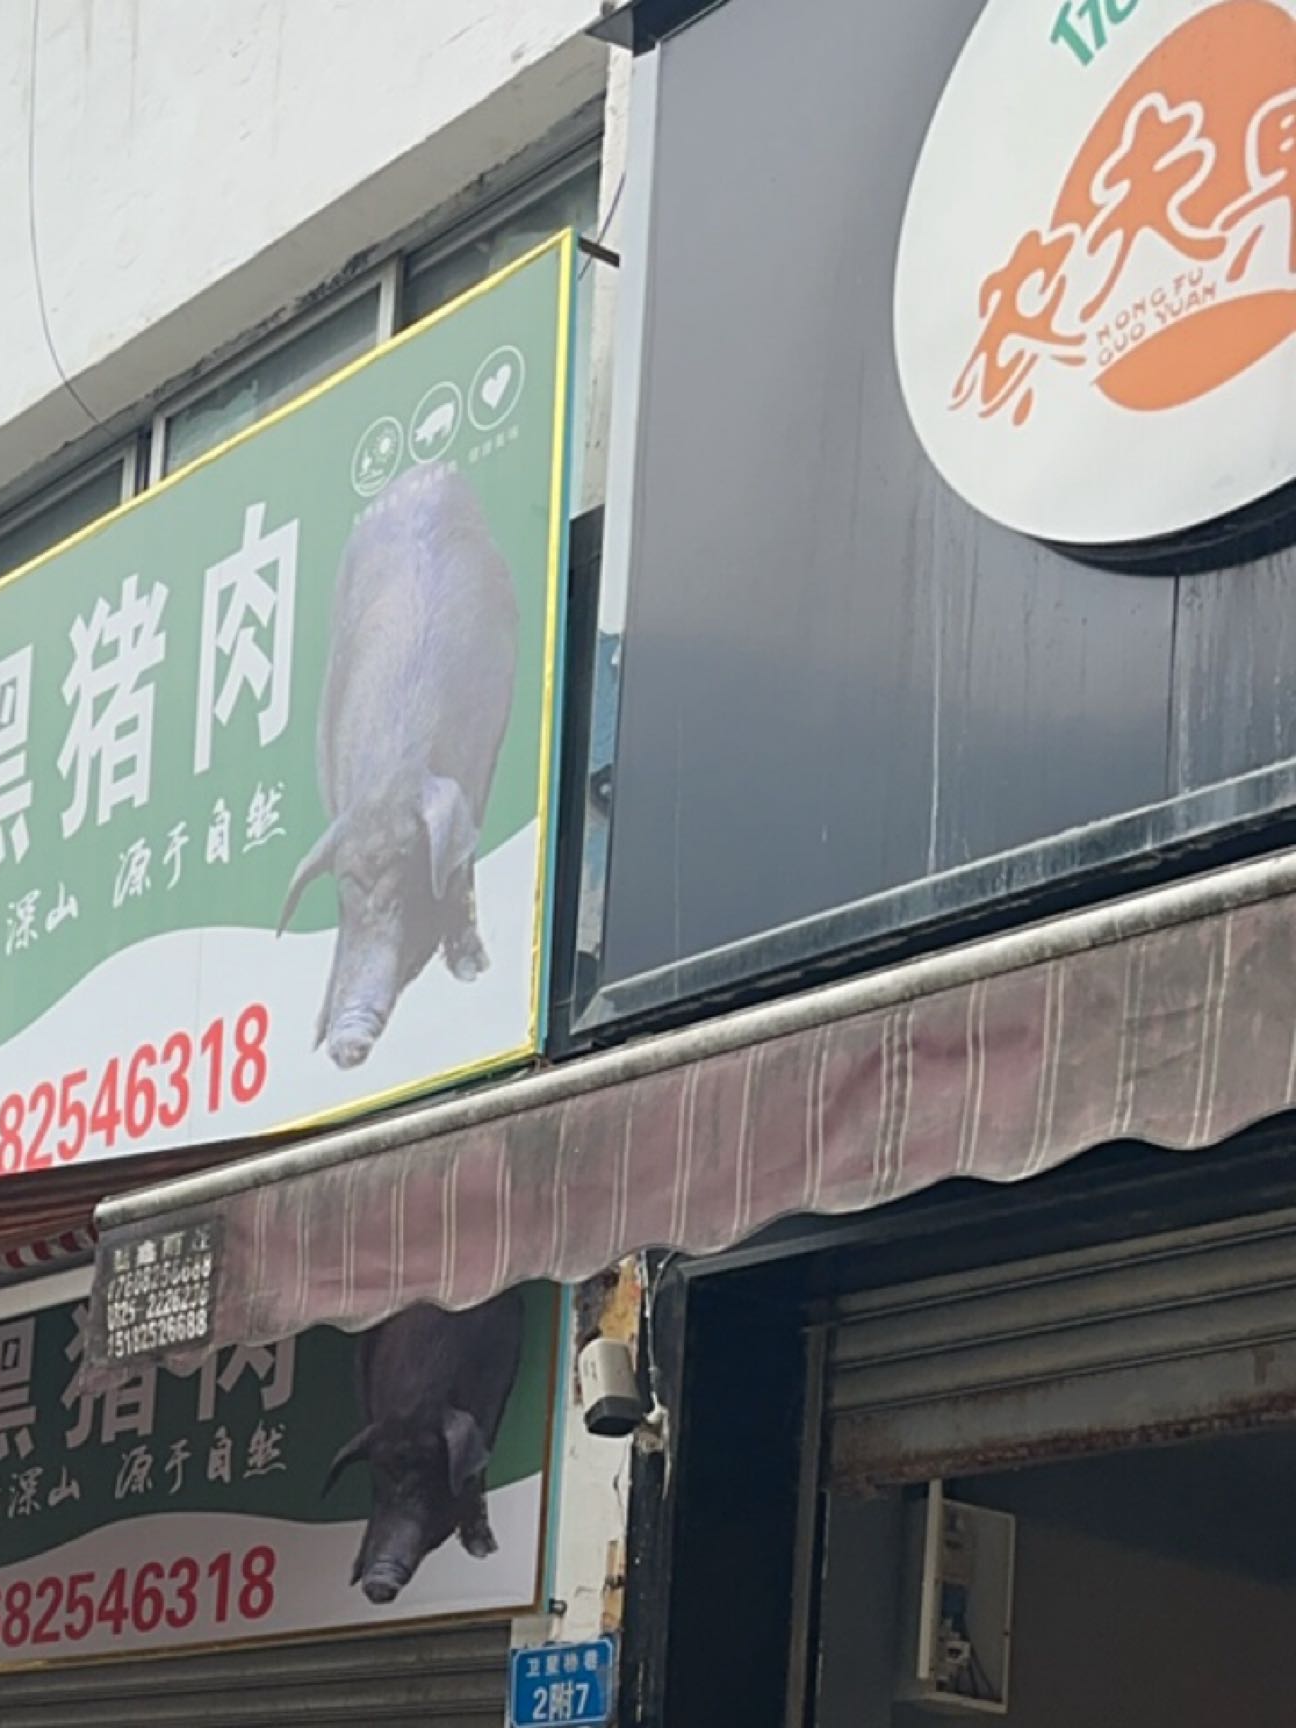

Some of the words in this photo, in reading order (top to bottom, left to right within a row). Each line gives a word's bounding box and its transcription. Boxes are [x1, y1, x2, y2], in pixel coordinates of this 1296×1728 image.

[1173, 266, 1204, 296] FU
[1098, 322, 1146, 368] GUO
[1153, 281, 1218, 325] YUAN
[111, 781, 288, 908] 源于自然
[115, 1421, 290, 1501] 源于自然
